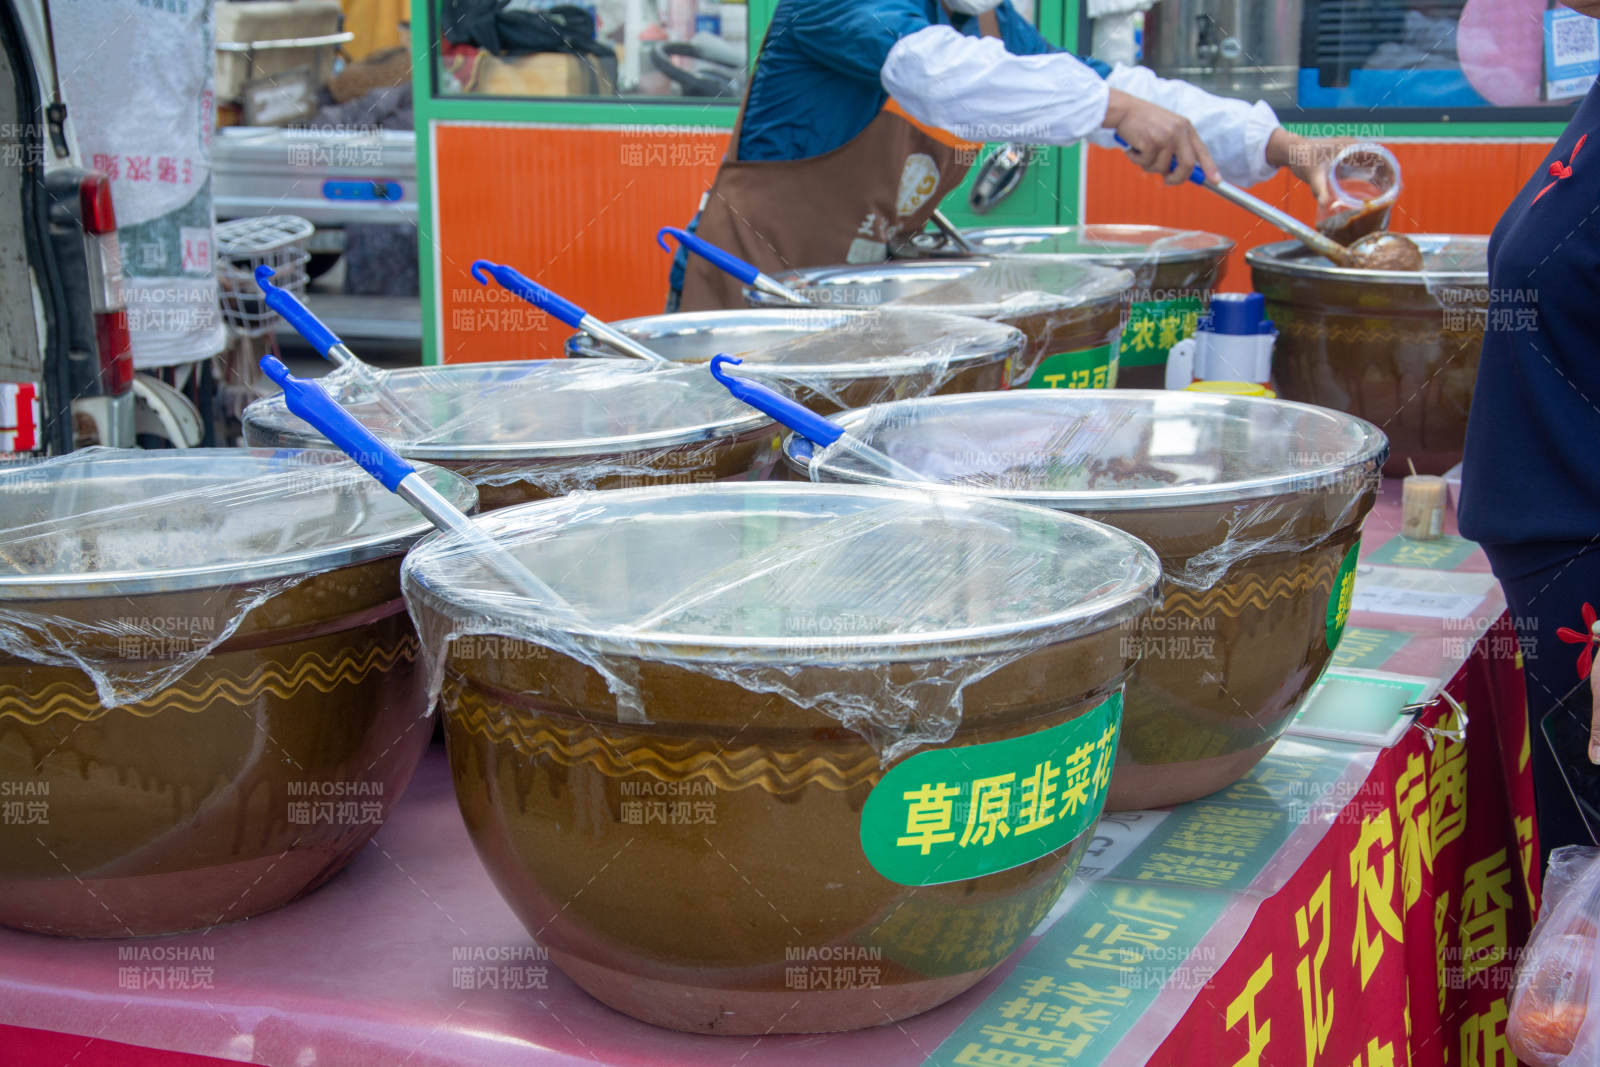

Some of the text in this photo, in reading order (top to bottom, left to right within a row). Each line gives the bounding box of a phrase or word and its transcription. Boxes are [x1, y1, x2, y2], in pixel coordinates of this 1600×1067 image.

[1120, 312, 1197, 353] 农家
[896, 723, 1117, 856] 草原韭菜花
